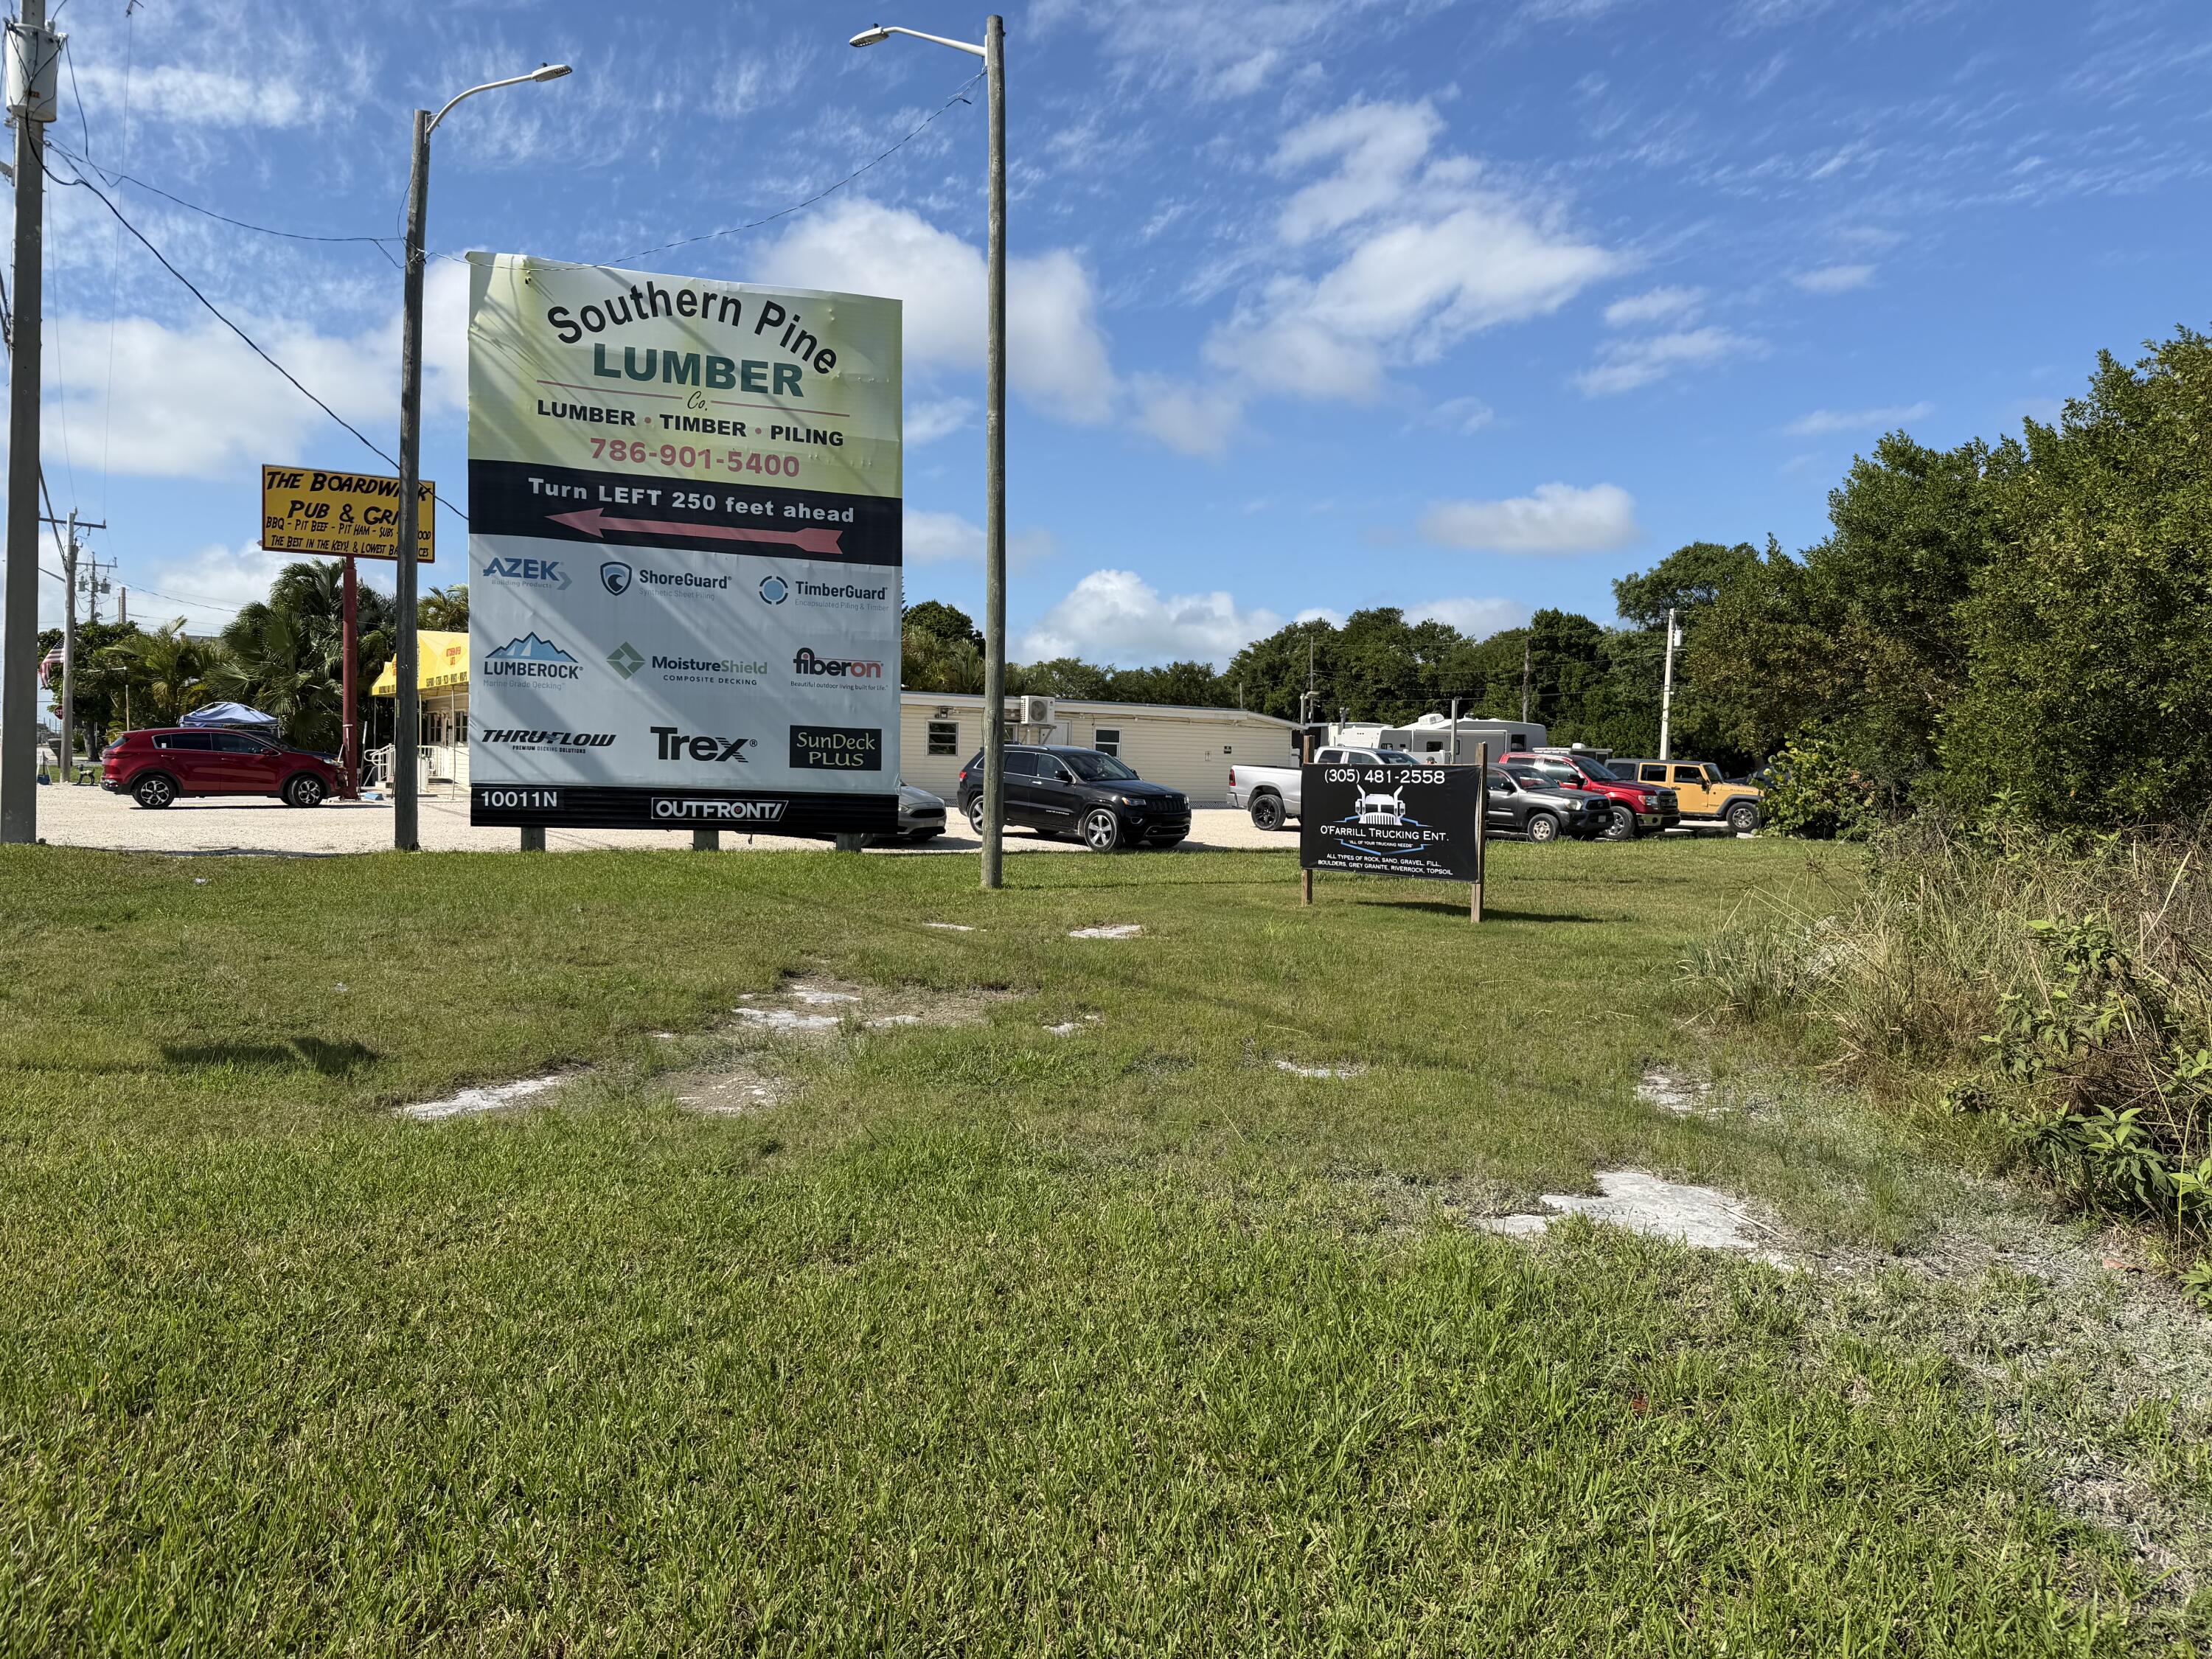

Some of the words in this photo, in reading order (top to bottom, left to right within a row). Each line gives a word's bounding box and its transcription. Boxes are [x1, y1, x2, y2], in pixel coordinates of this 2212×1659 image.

[548, 281, 742, 344] Southern
[754, 300, 837, 375] Pine
[594, 343, 804, 397] LUMBER
[687, 392, 708, 411] Co.
[538, 399, 636, 426] LUMBER
[659, 414, 747, 437] TIMBER
[771, 425, 844, 447] PILING
[590, 438, 799, 478] 786-901-5400
[267, 471, 305, 490] THE
[310, 473, 431, 501] BOARDWK
[529, 477, 587, 500] Turn
[599, 485, 662, 507] LEFT
[672, 492, 715, 511] 250
[726, 496, 773, 516] feet
[783, 502, 854, 523] ahead
[287, 500, 330, 518] PUB
[339, 504, 354, 524] &
[266, 516, 284, 530] BBQ
[295, 519, 309, 530] PIT
[310, 521, 328, 532] BEEF
[338, 523, 352, 535] PIT
[353, 524, 370, 535] HAM
[379, 526, 393, 538] SUBS
[271, 535, 285, 546] THE
[287, 536, 303, 547] BEST
[306, 538, 315, 548] IN
[317, 539, 332, 549] THE
[331, 540, 349, 552] KEYS!
[352, 541, 358, 553] &
[361, 543, 386, 554] LOWEST
[483, 557, 560, 581] AZEK
[492, 579, 521, 588] Building
[522, 581, 552, 589] Products
[639, 588, 672, 598] Synthetic
[674, 590, 695, 598] Sheet
[696, 592, 715, 601] Piling
[795, 599, 839, 608] Encapsulated
[841, 602, 859, 611] Piling
[652, 655, 768, 675] MoistureShield
[793, 647, 881, 678] fiberon
[664, 675, 714, 683] COMPOSITE
[796, 732, 875, 750] SunDeck
[809, 751, 864, 766] PLUS
[1324, 769, 1360, 784] (305)
[1364, 770, 1445, 785] 481-2558
[481, 790, 557, 808] 10011N
[1320, 825, 1366, 837] O'FARRILL
[1368, 828, 1419, 839] TRUCKING
[1423, 831, 1450, 841] ENT.
